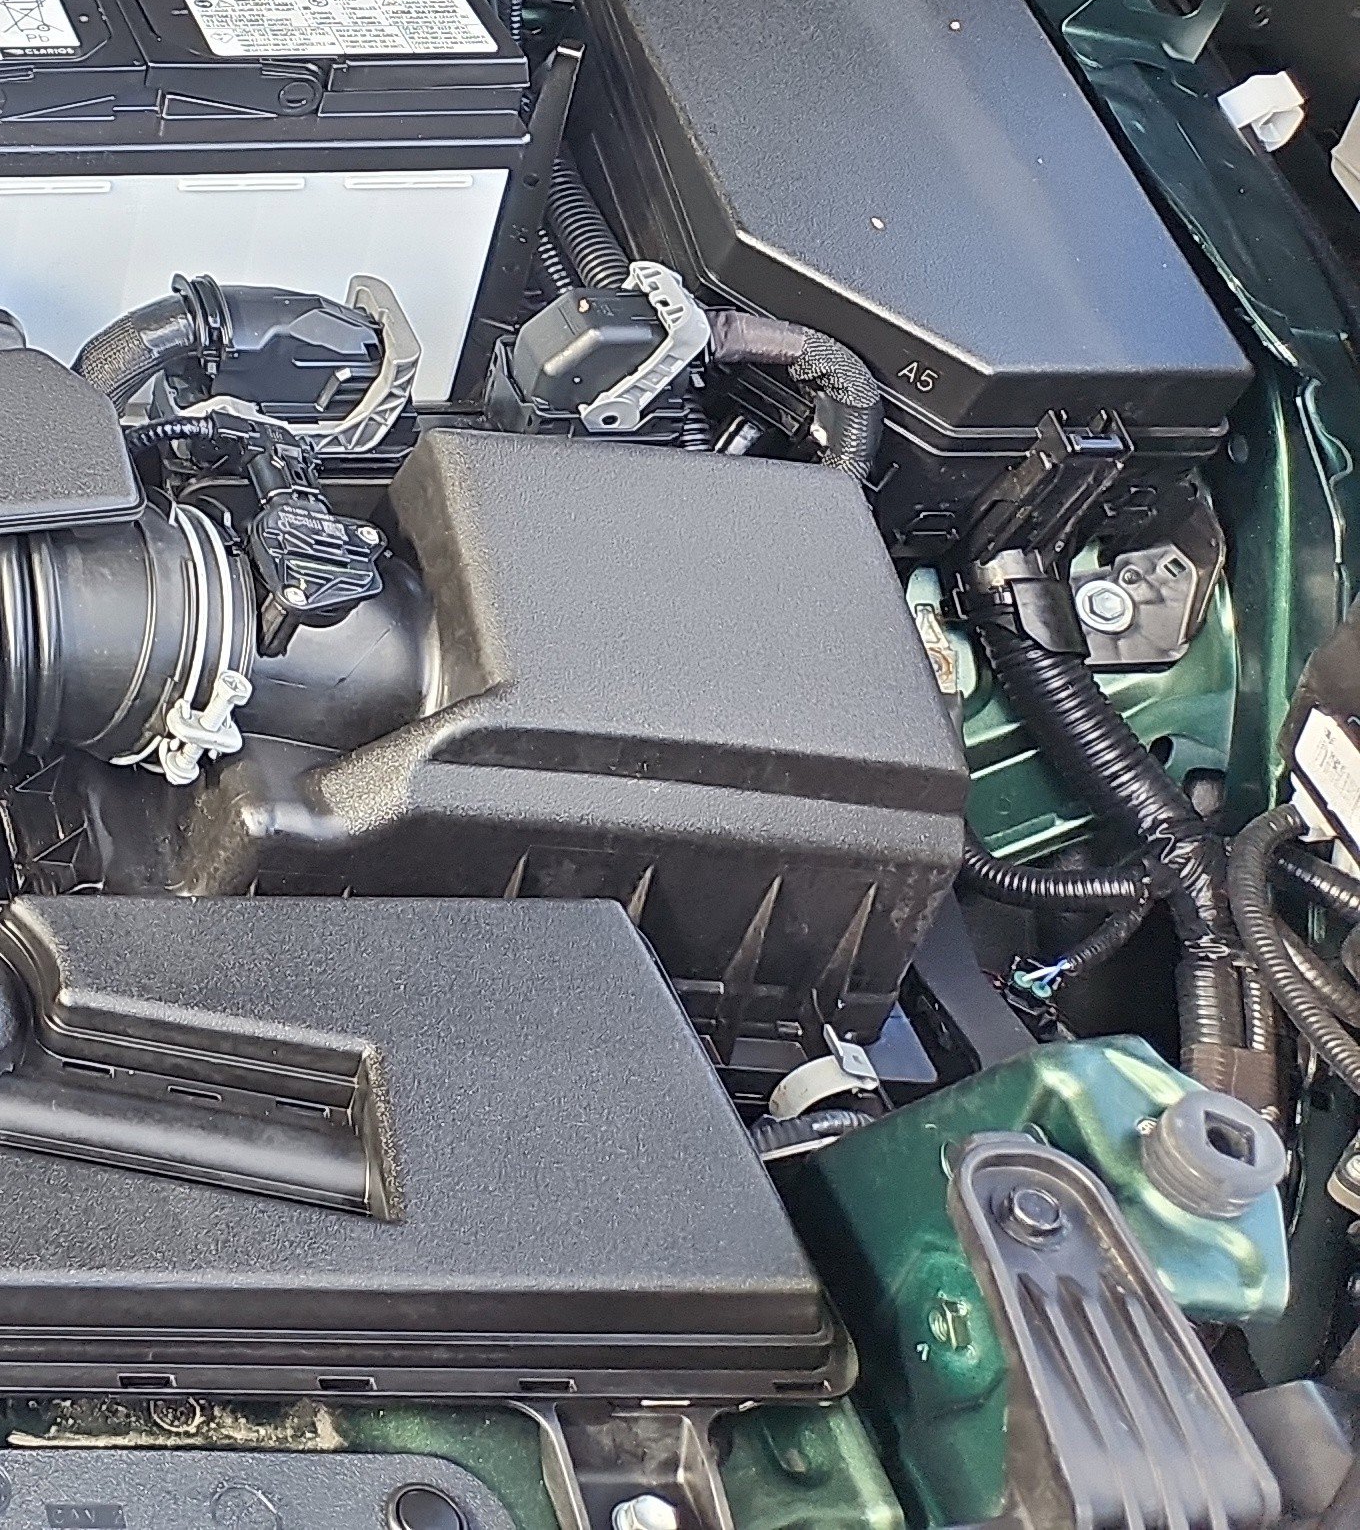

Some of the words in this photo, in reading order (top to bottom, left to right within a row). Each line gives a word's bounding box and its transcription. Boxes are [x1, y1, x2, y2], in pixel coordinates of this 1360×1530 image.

[25, 33, 50, 43] Pb
[24, 47, 75, 55] CLARIOS
[897, 360, 940, 393] A5
